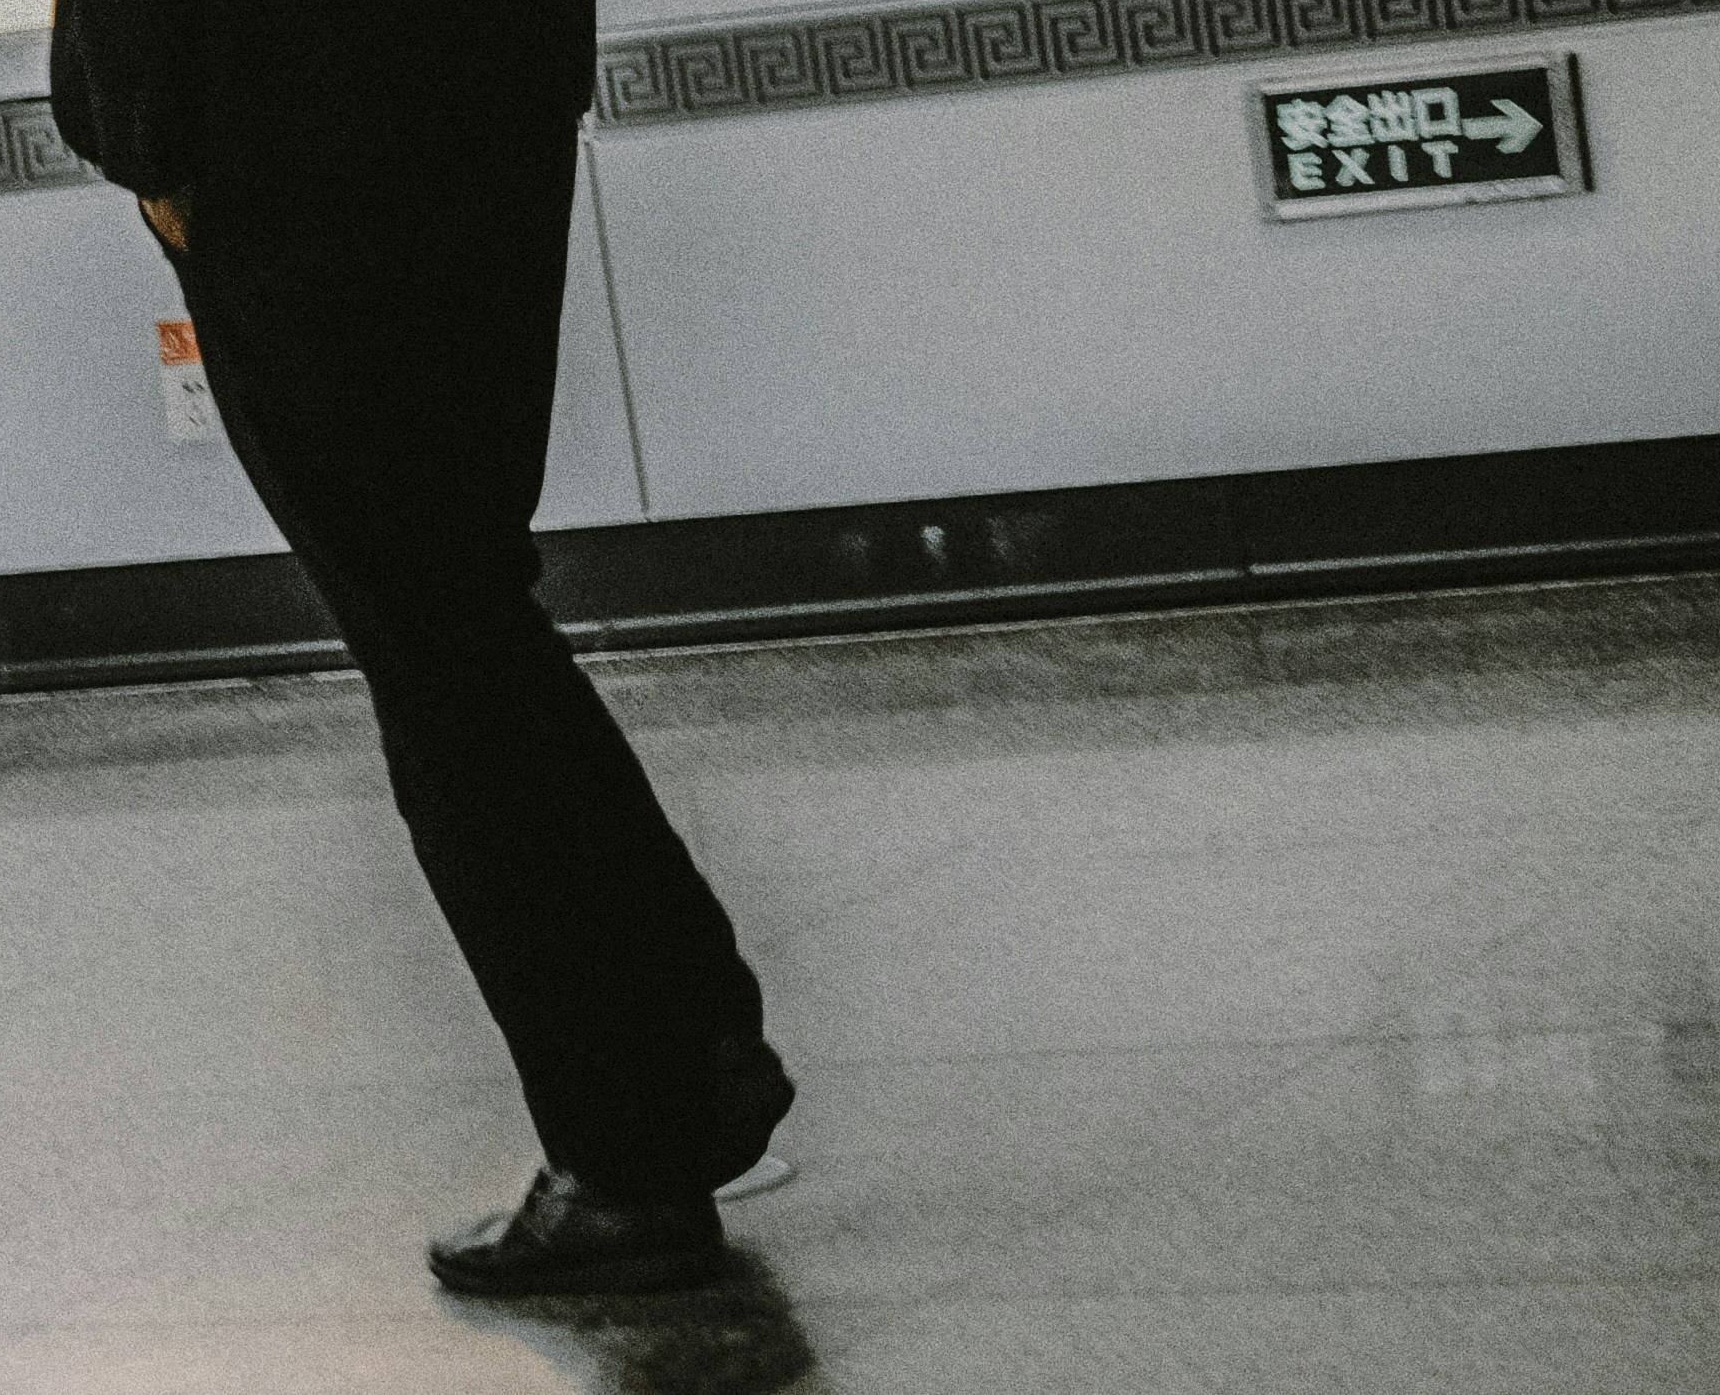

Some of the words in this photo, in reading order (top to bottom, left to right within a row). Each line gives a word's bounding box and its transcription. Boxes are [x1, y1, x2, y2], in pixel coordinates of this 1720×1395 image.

[1276, 86, 1463, 152] 安全出口
[1286, 139, 1459, 191] EXIT
